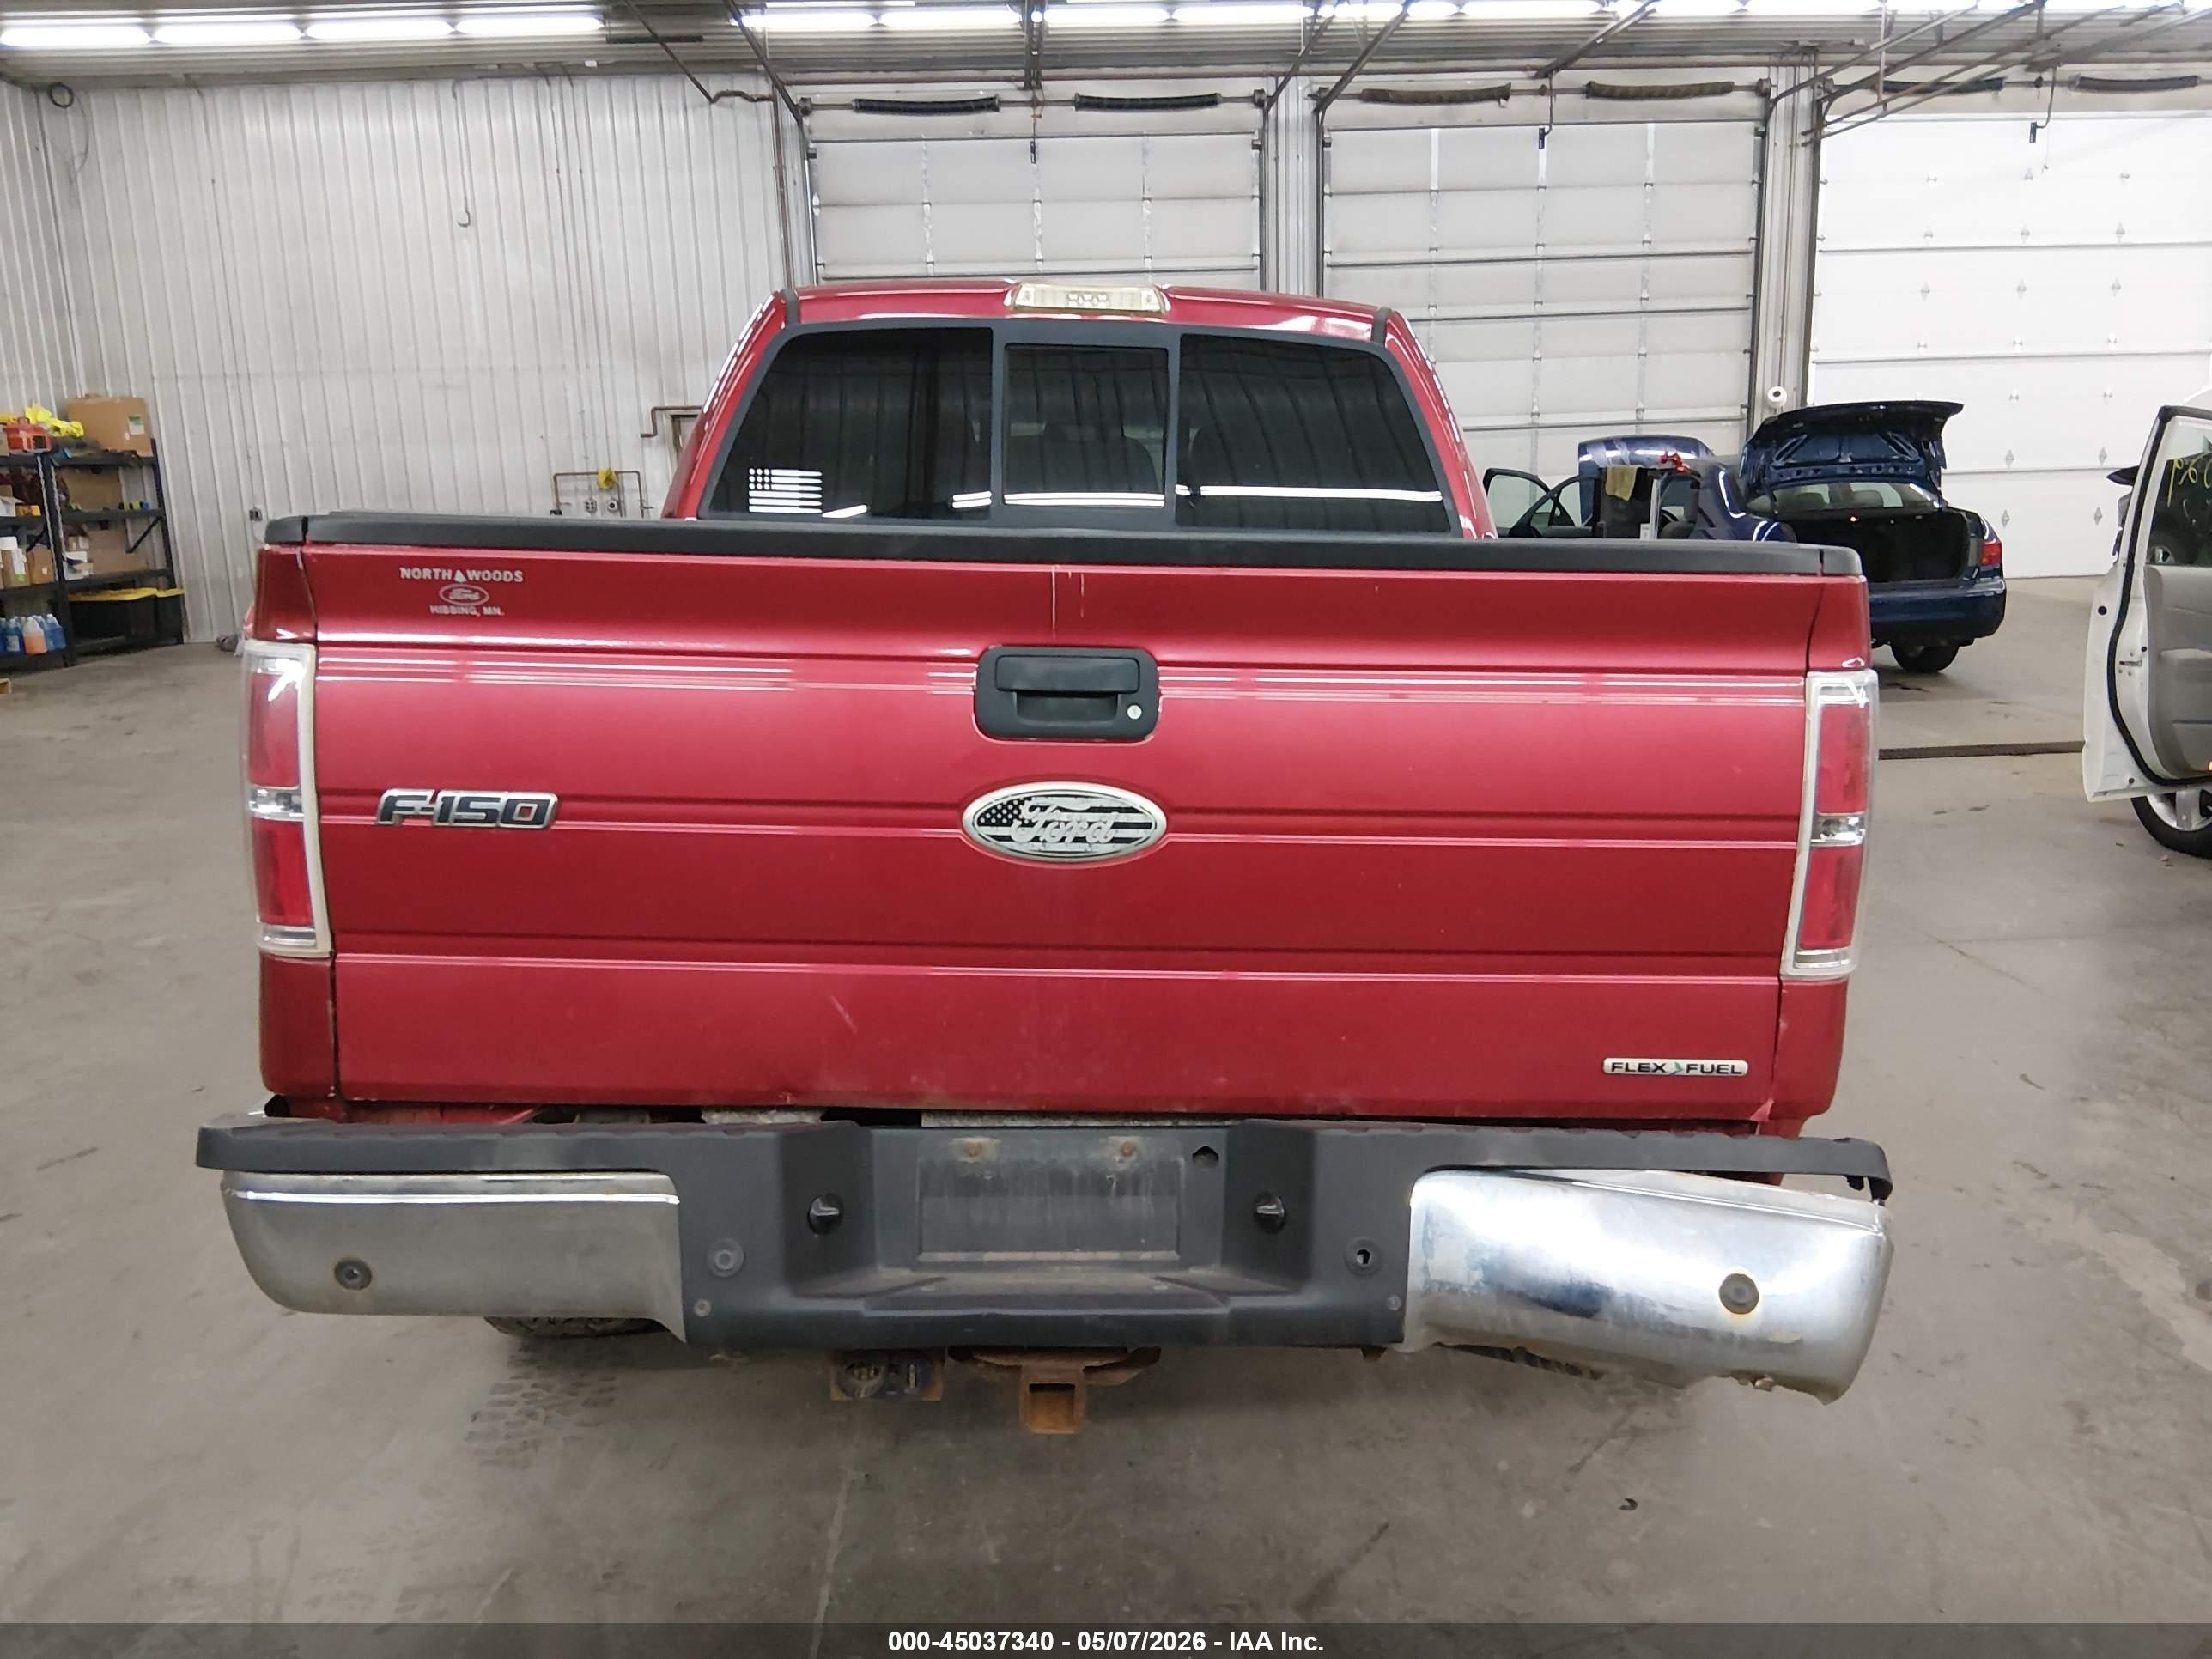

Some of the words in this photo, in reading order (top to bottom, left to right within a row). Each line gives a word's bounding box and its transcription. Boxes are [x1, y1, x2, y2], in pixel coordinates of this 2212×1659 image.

[399, 567, 452, 580] NORTH
[466, 569, 523, 582] WOODS
[375, 788, 559, 829] F-150
[1009, 797, 1118, 843] Ford
[1611, 1062, 1667, 1073] FLEX
[1686, 1064, 1742, 1075] FUEL
